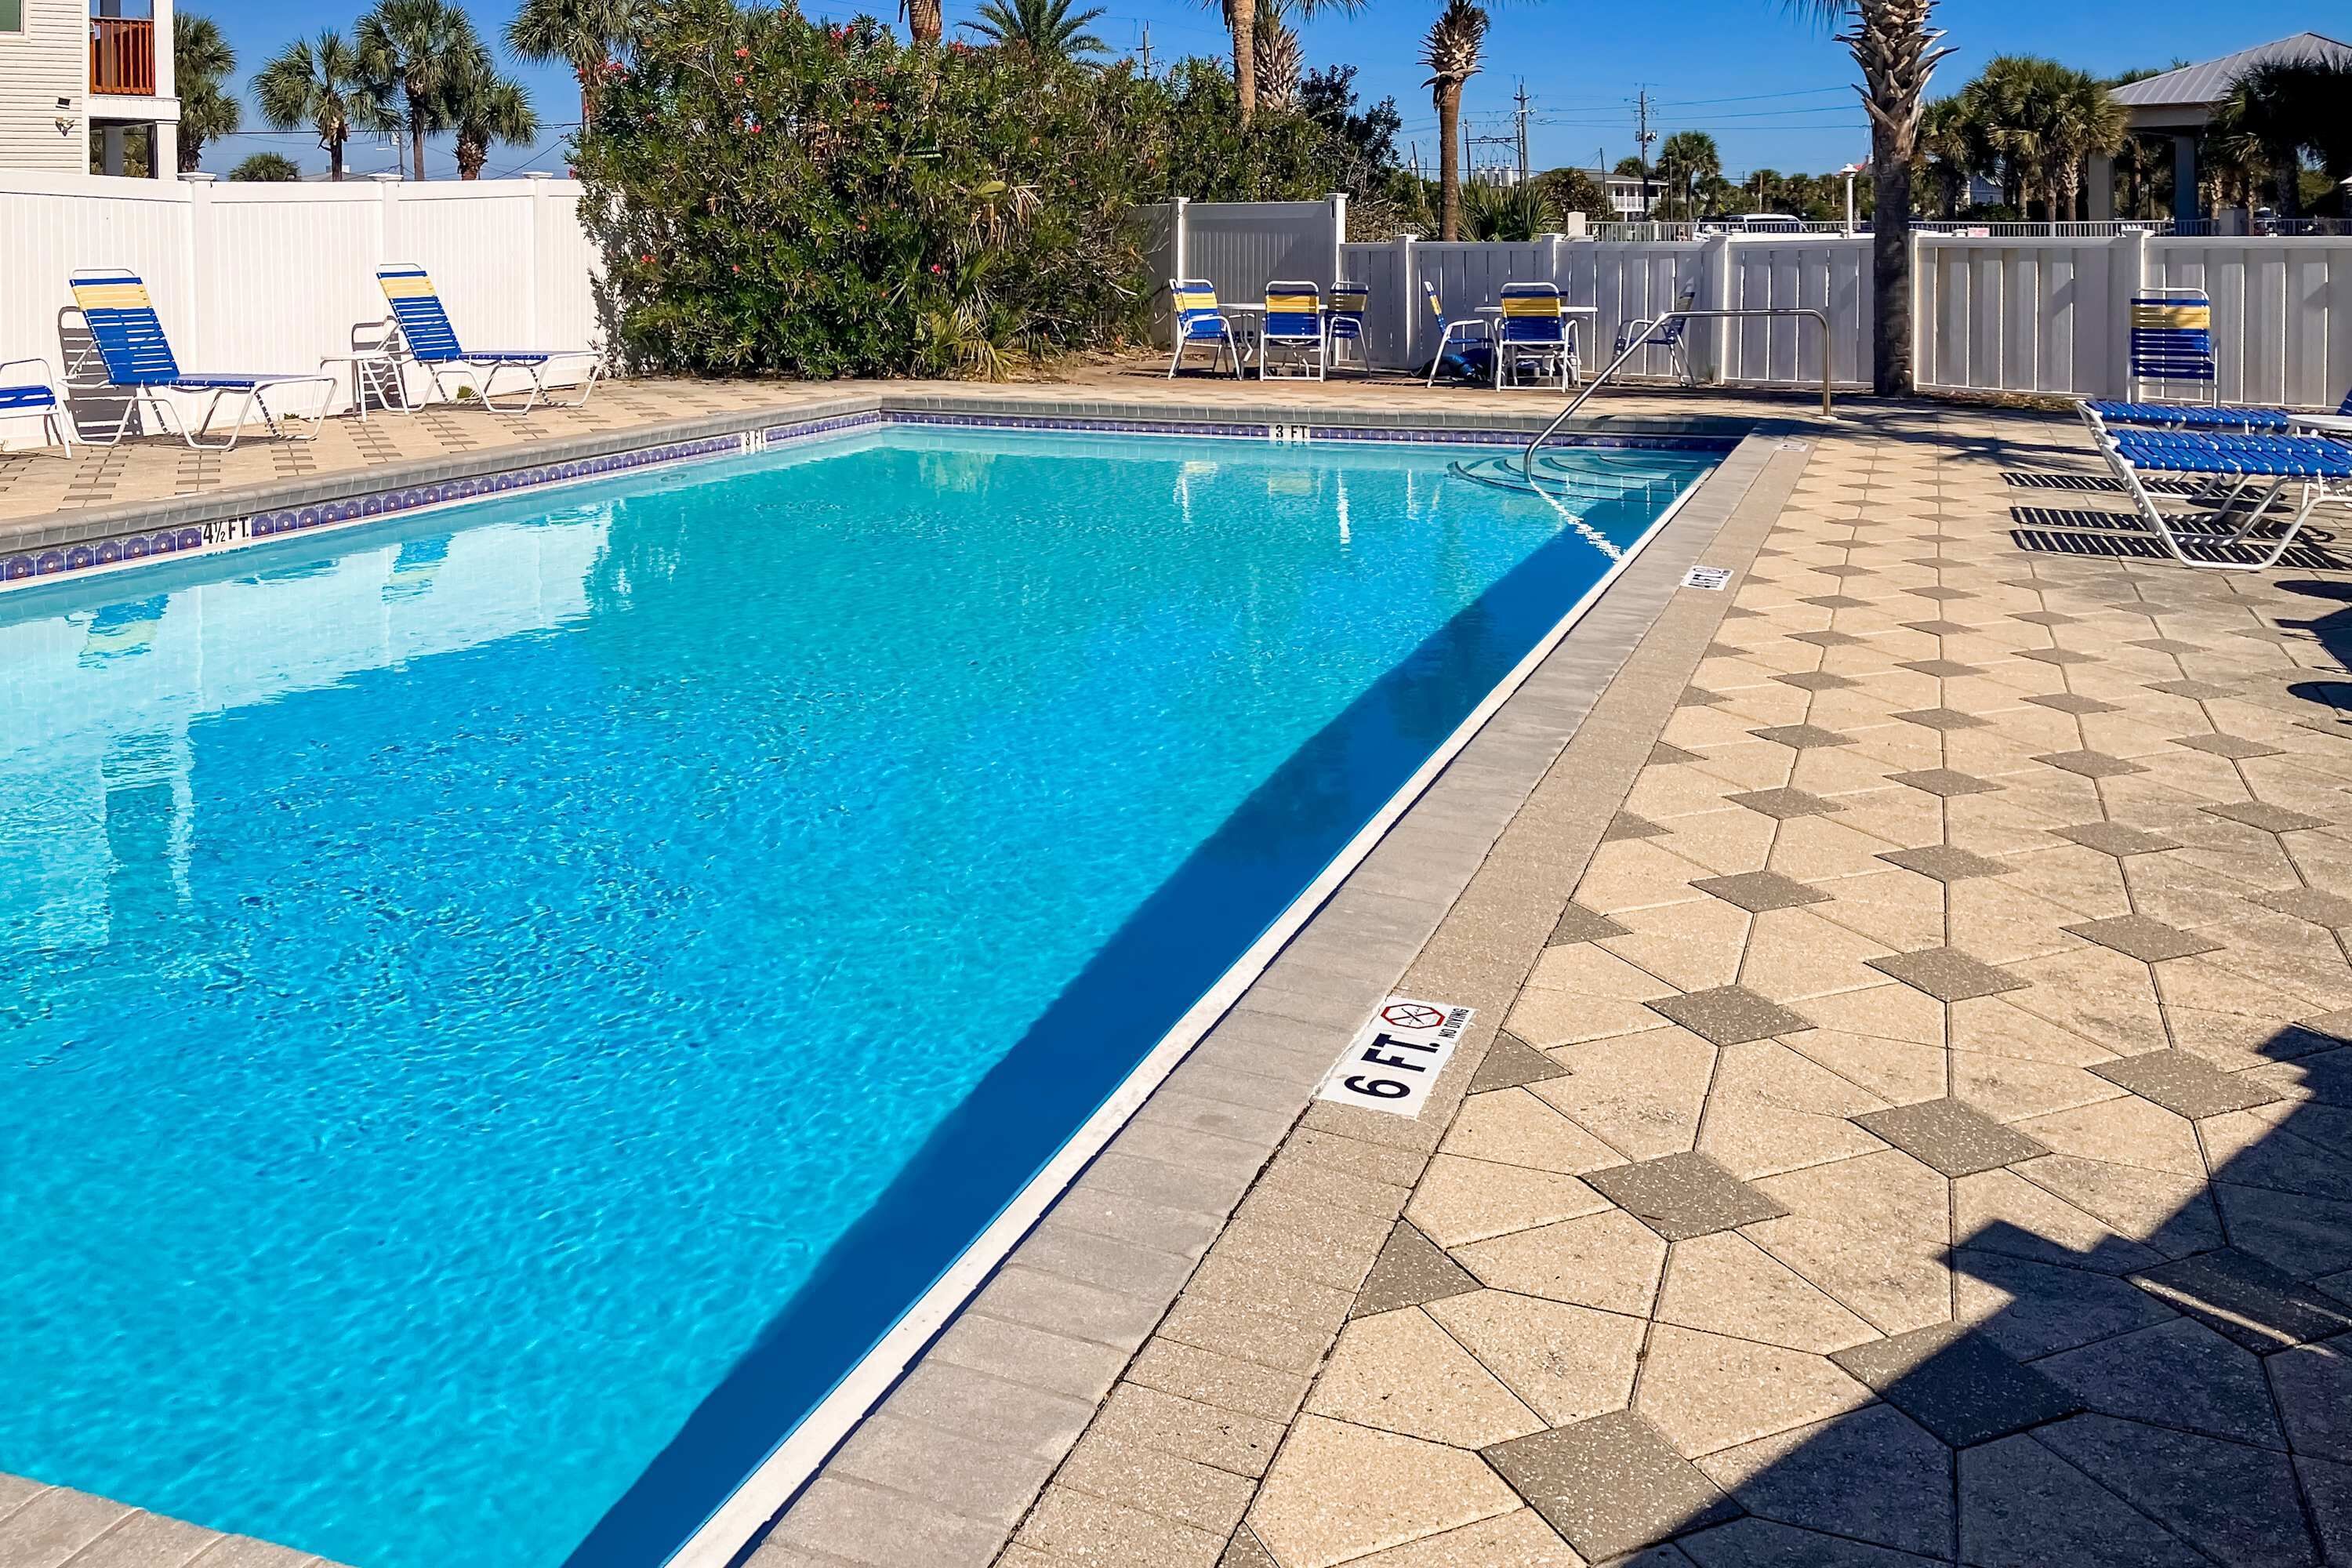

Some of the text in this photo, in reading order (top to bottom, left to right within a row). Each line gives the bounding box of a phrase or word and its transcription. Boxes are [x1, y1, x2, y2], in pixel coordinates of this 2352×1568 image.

[745, 430, 750, 446] 3
[1276, 424, 1308, 439] 3 FT.
[228, 516, 249, 540] FT.
[1438, 1008, 1470, 1039] NO DIVING
[1344, 1033, 1441, 1099] 6 FT.
